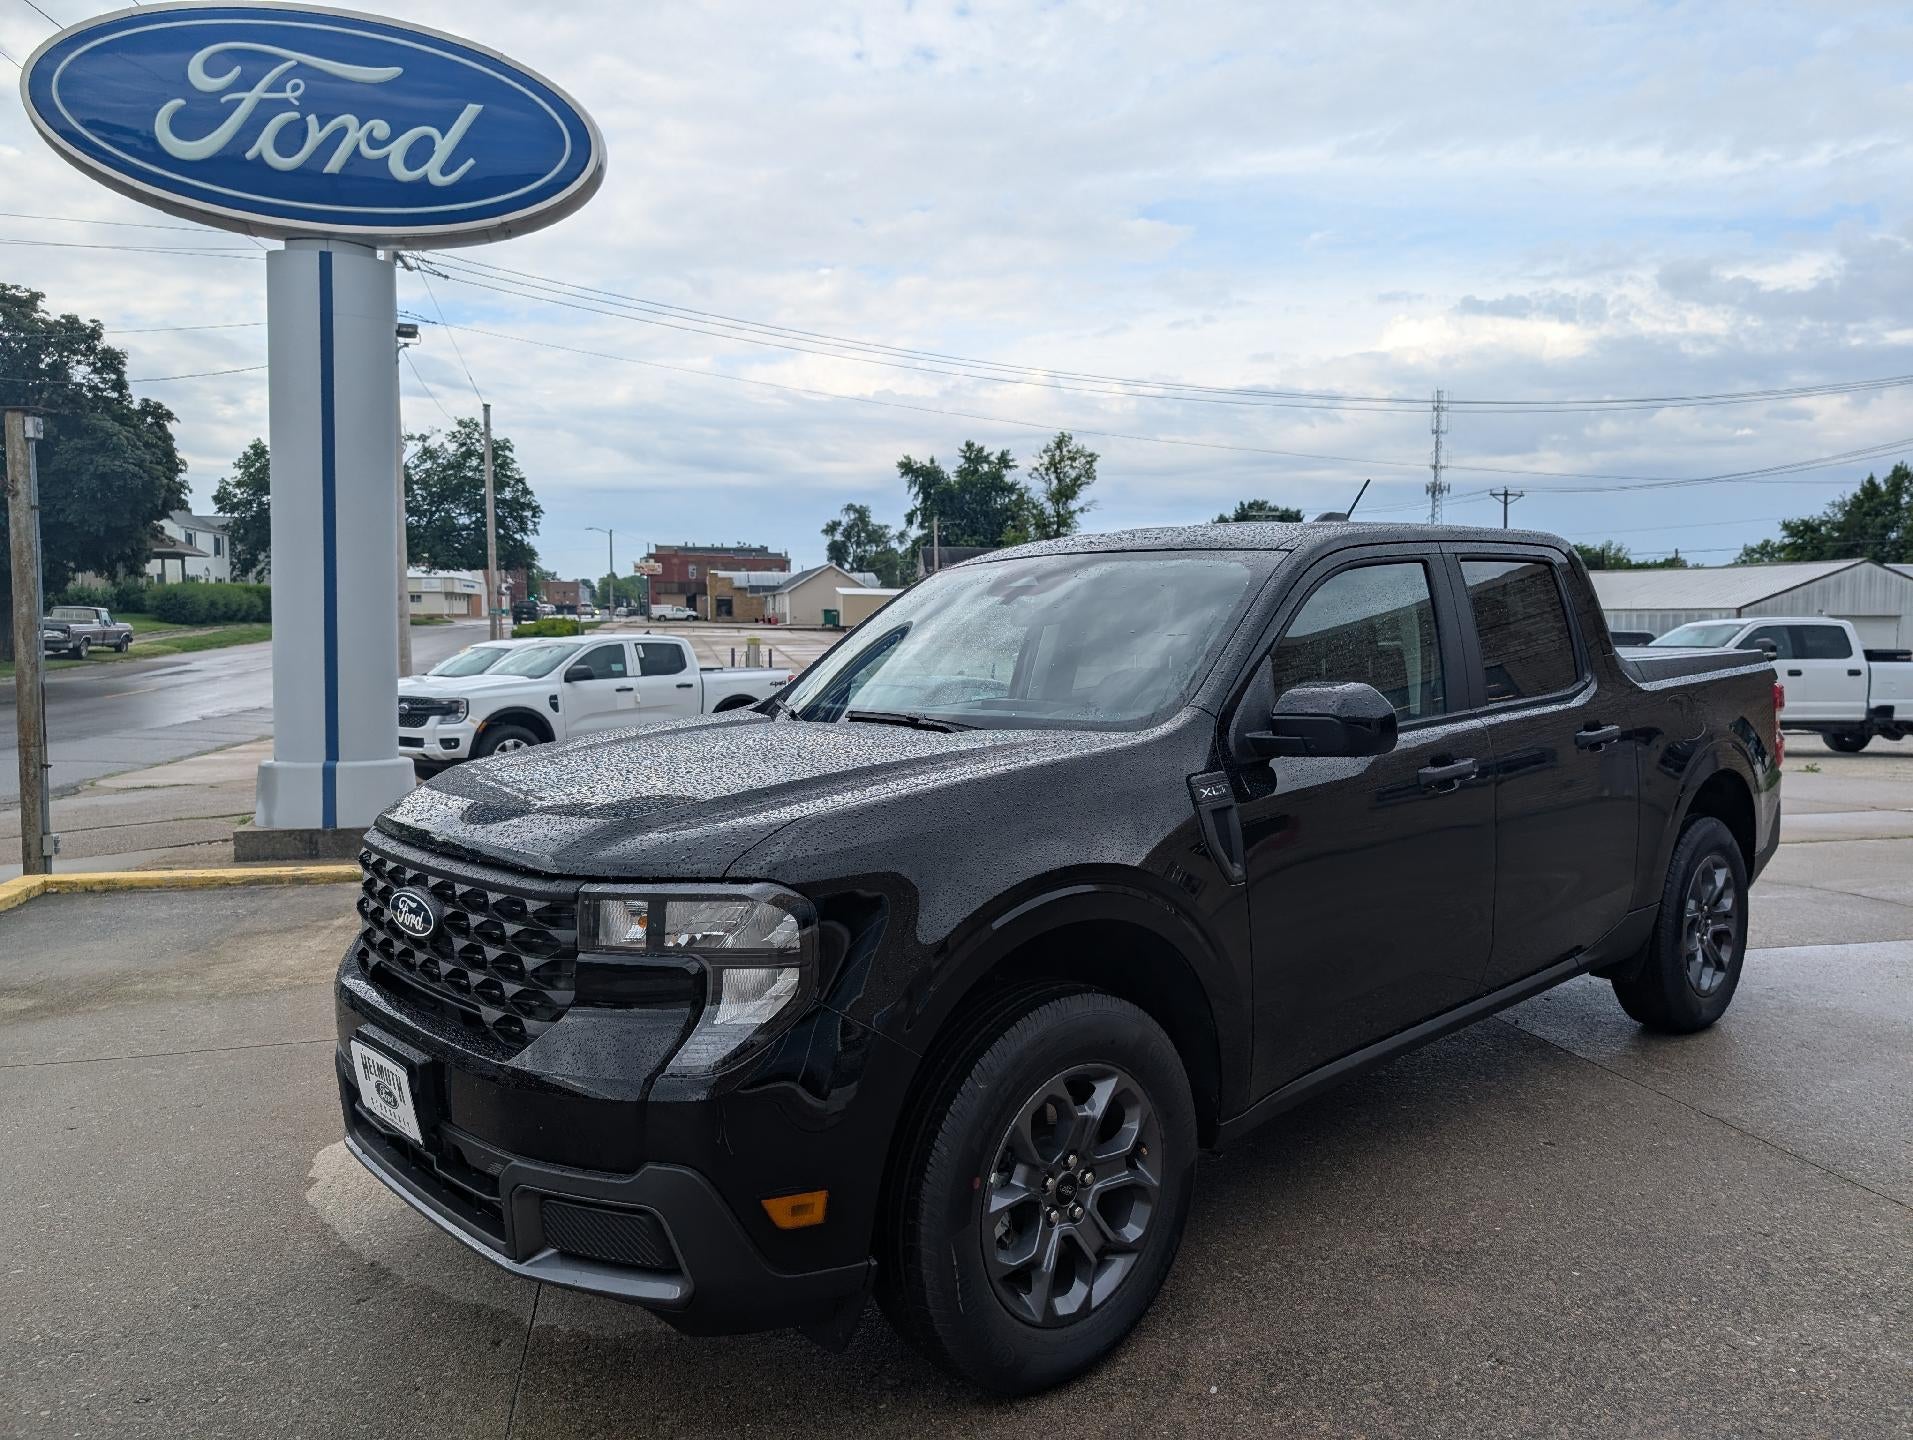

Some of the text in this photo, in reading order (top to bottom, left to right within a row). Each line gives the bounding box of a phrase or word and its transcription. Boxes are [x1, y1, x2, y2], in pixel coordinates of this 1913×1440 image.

[154, 42, 484, 187] Ford
[1200, 784, 1228, 798] XLT
[398, 897, 424, 930] Ford
[361, 1053, 406, 1105] HELMUTH
